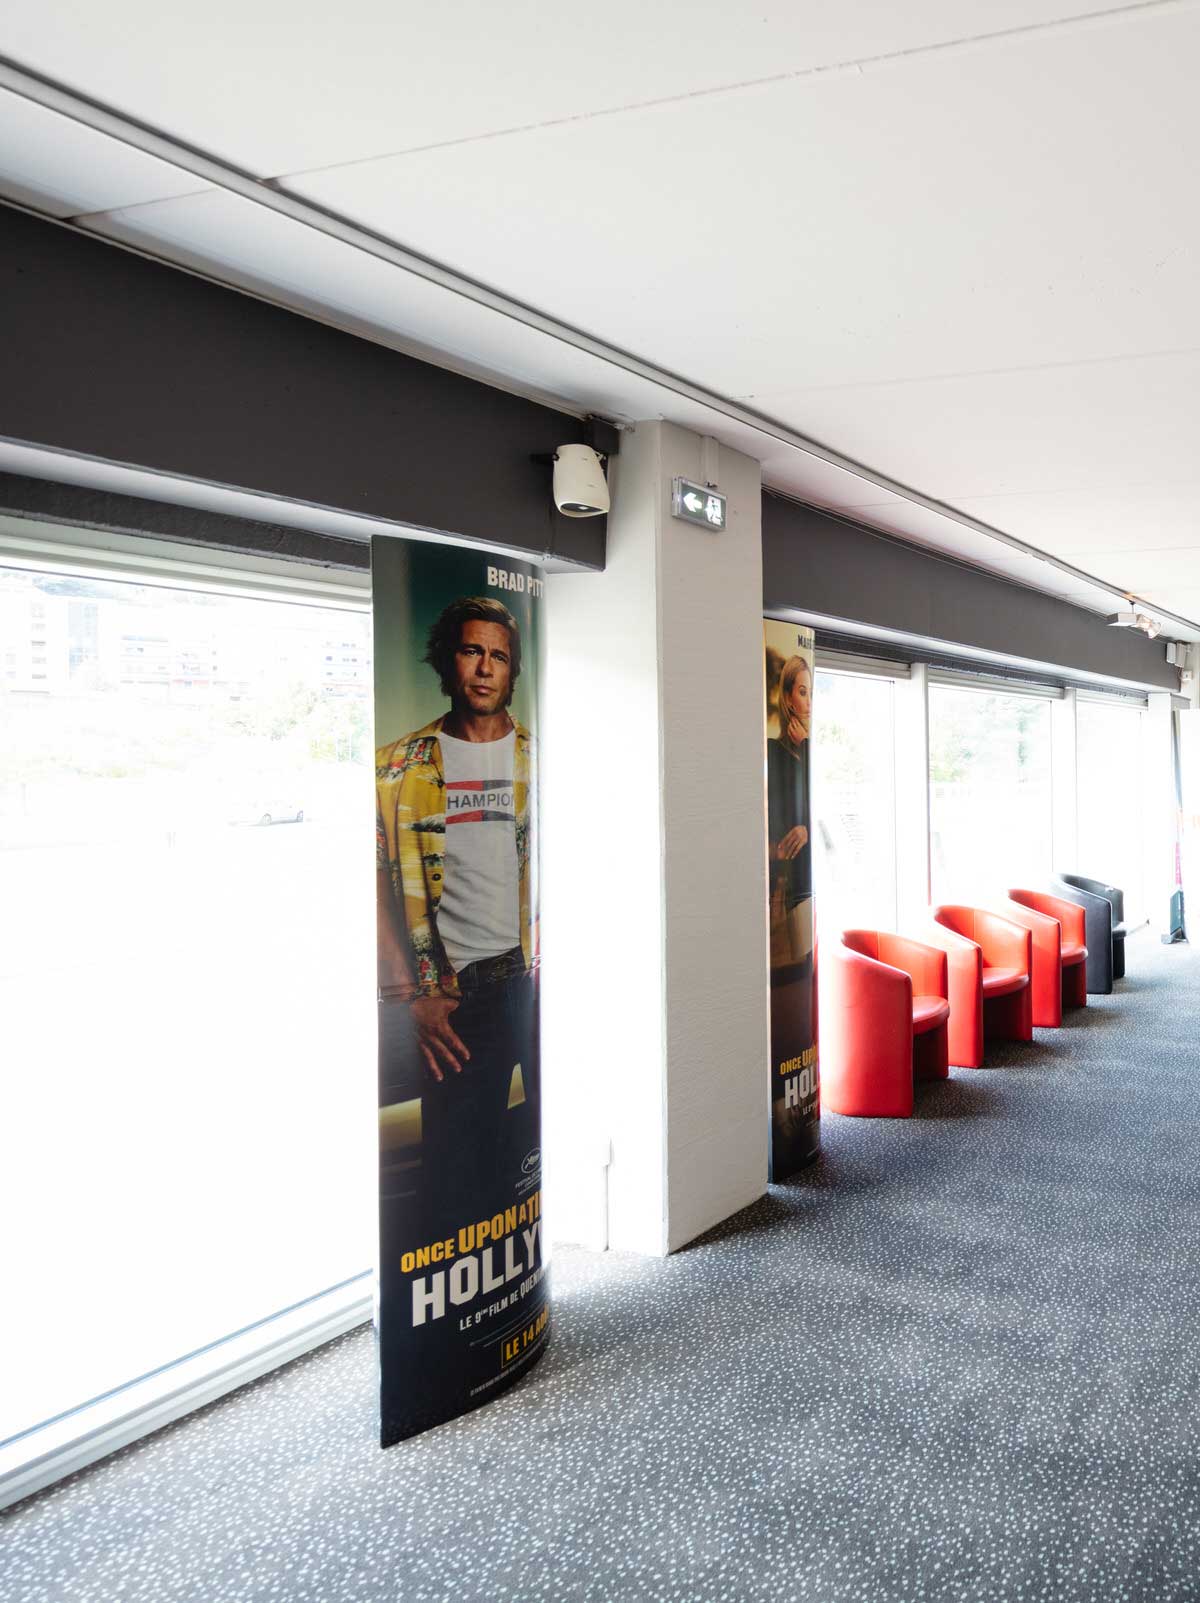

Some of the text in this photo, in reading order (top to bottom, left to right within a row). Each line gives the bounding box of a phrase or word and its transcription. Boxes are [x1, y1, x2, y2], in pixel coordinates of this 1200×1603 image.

[487, 566, 544, 599] BRAD PITT
[447, 792, 514, 809] HAMPIO
[780, 1056, 802, 1076] ONCE
[785, 1064, 819, 1109] HOL
[400, 1190, 542, 1273] ONCE UPON A TI
[460, 1315, 473, 1332] LE
[510, 1289, 519, 1305] DE
[506, 1336, 519, 1361] LE
[523, 1323, 535, 1347] 14
